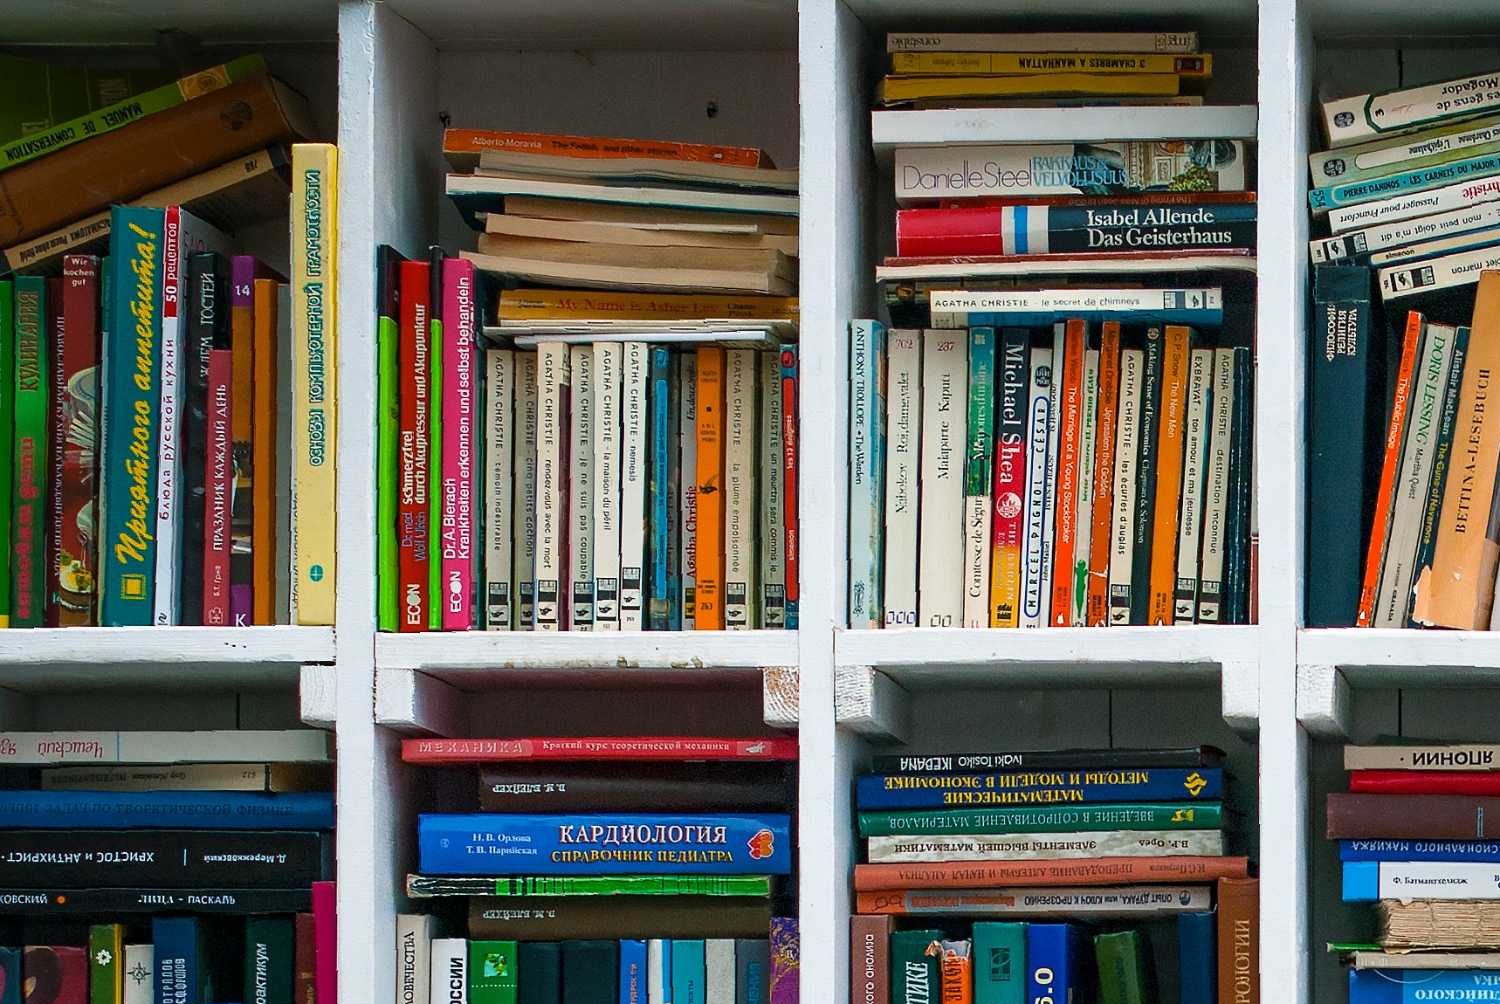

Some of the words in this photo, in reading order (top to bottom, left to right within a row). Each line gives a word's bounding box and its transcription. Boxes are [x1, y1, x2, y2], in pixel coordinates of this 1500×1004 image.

[904, 160, 982, 191] Danielle
[984, 153, 1032, 187] Steel
[1088, 210, 1138, 227] Isabel
[1144, 208, 1215, 224] Allende
[167, 223, 179, 281] рецептов
[1088, 229, 1123, 248] Das
[1125, 228, 1233, 246] Geisterhaus
[129, 223, 157, 392] аппетита!
[165, 284, 177, 303] 50
[458, 277, 470, 346] behandeln
[458, 347, 470, 387] selbst
[1002, 342, 1025, 426] Michael
[458, 389, 470, 414] und
[163, 396, 176, 462] русской
[458, 418, 471, 478] erkennen
[1000, 432, 1022, 485] Shea
[117, 400, 153, 565] Приятного
[457, 481, 471, 559] Krankheiten
[1412, 751, 1493, 765] ЯПОНИИ
[884, 776, 982, 789] ЭКОНОМИКЕ
[1000, 774, 1064, 787] МОДЕЛИ
[1085, 772, 1149, 785] МЕТОДЫ
[944, 791, 1083, 804] МАТЕМАТИЧЕСКИЕ
[559, 825, 727, 845] КАРДИОЛОГИЯ
[551, 849, 653, 863] СПРАВОЧНИК
[657, 850, 733, 863] ПЕДИАТРА
